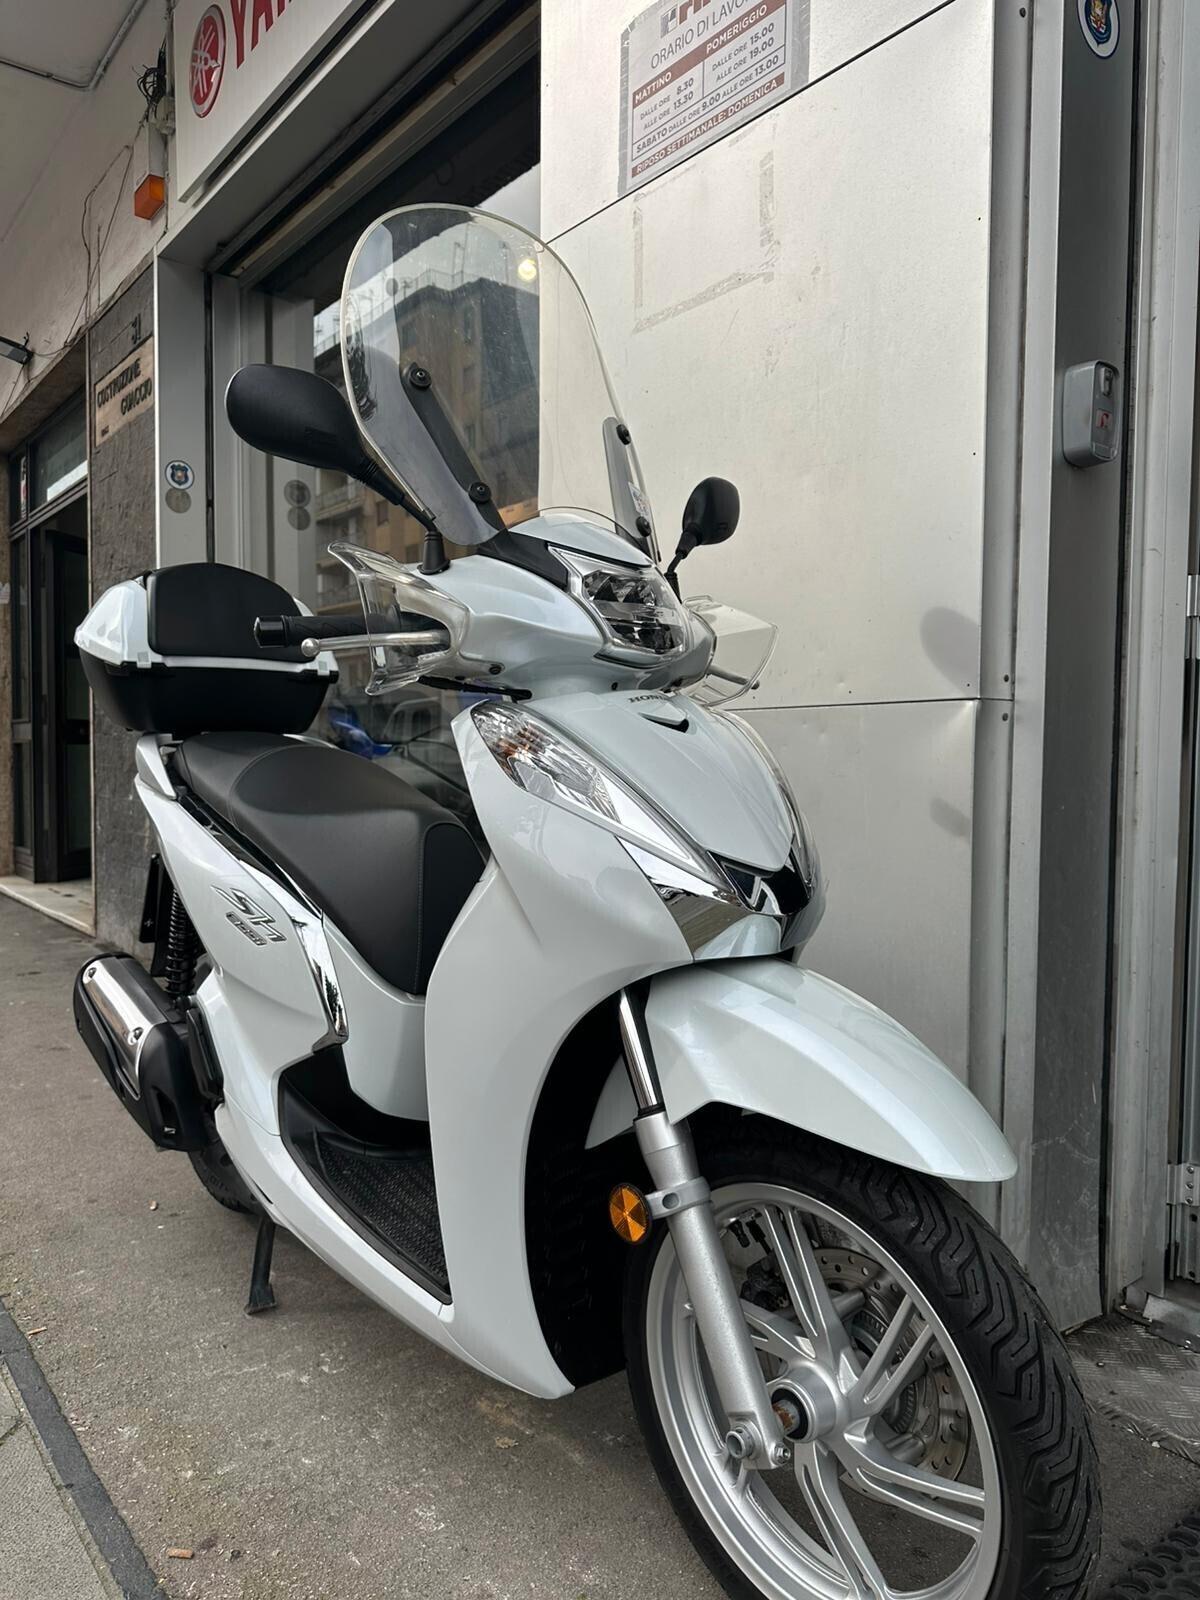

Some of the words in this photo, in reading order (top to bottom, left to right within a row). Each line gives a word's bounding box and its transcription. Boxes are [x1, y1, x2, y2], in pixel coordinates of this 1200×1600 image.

[230, 0, 290, 69] YA
[651, 28, 694, 69] ORARIO
[696, 20, 709, 37] DI
[712, 0, 749, 26] LAVO
[706, 5, 767, 53] POMERIGGIO
[712, 52, 732, 71] DALLE
[734, 42, 747, 57] ORE
[750, 23, 774, 45] 15.00
[716, 67, 732, 82] ALLE
[734, 57, 747, 70] ORE
[750, 37, 774, 59] 19.00
[635, 72, 672, 104] MATTINO
[636, 128, 668, 153] SABATO
[668, 115, 687, 133] DALLE
[687, 108, 701, 120] ORE
[701, 93, 721, 111] 9.00
[721, 82, 738, 98] ALLE
[739, 73, 754, 86] ORE
[754, 55, 779, 77] 13.00
[640, 103, 658, 120] DALLE
[658, 94, 671, 108] ORE
[676, 77, 694, 95] 8.30
[643, 116, 658, 130] ALLE
[659, 108, 671, 119] ORE
[673, 91, 694, 110] 13.30
[636, 150, 666, 174] RIPOSO
[666, 110, 727, 155] SETTIMANALE:
[728, 79, 778, 117] DOMENICA
